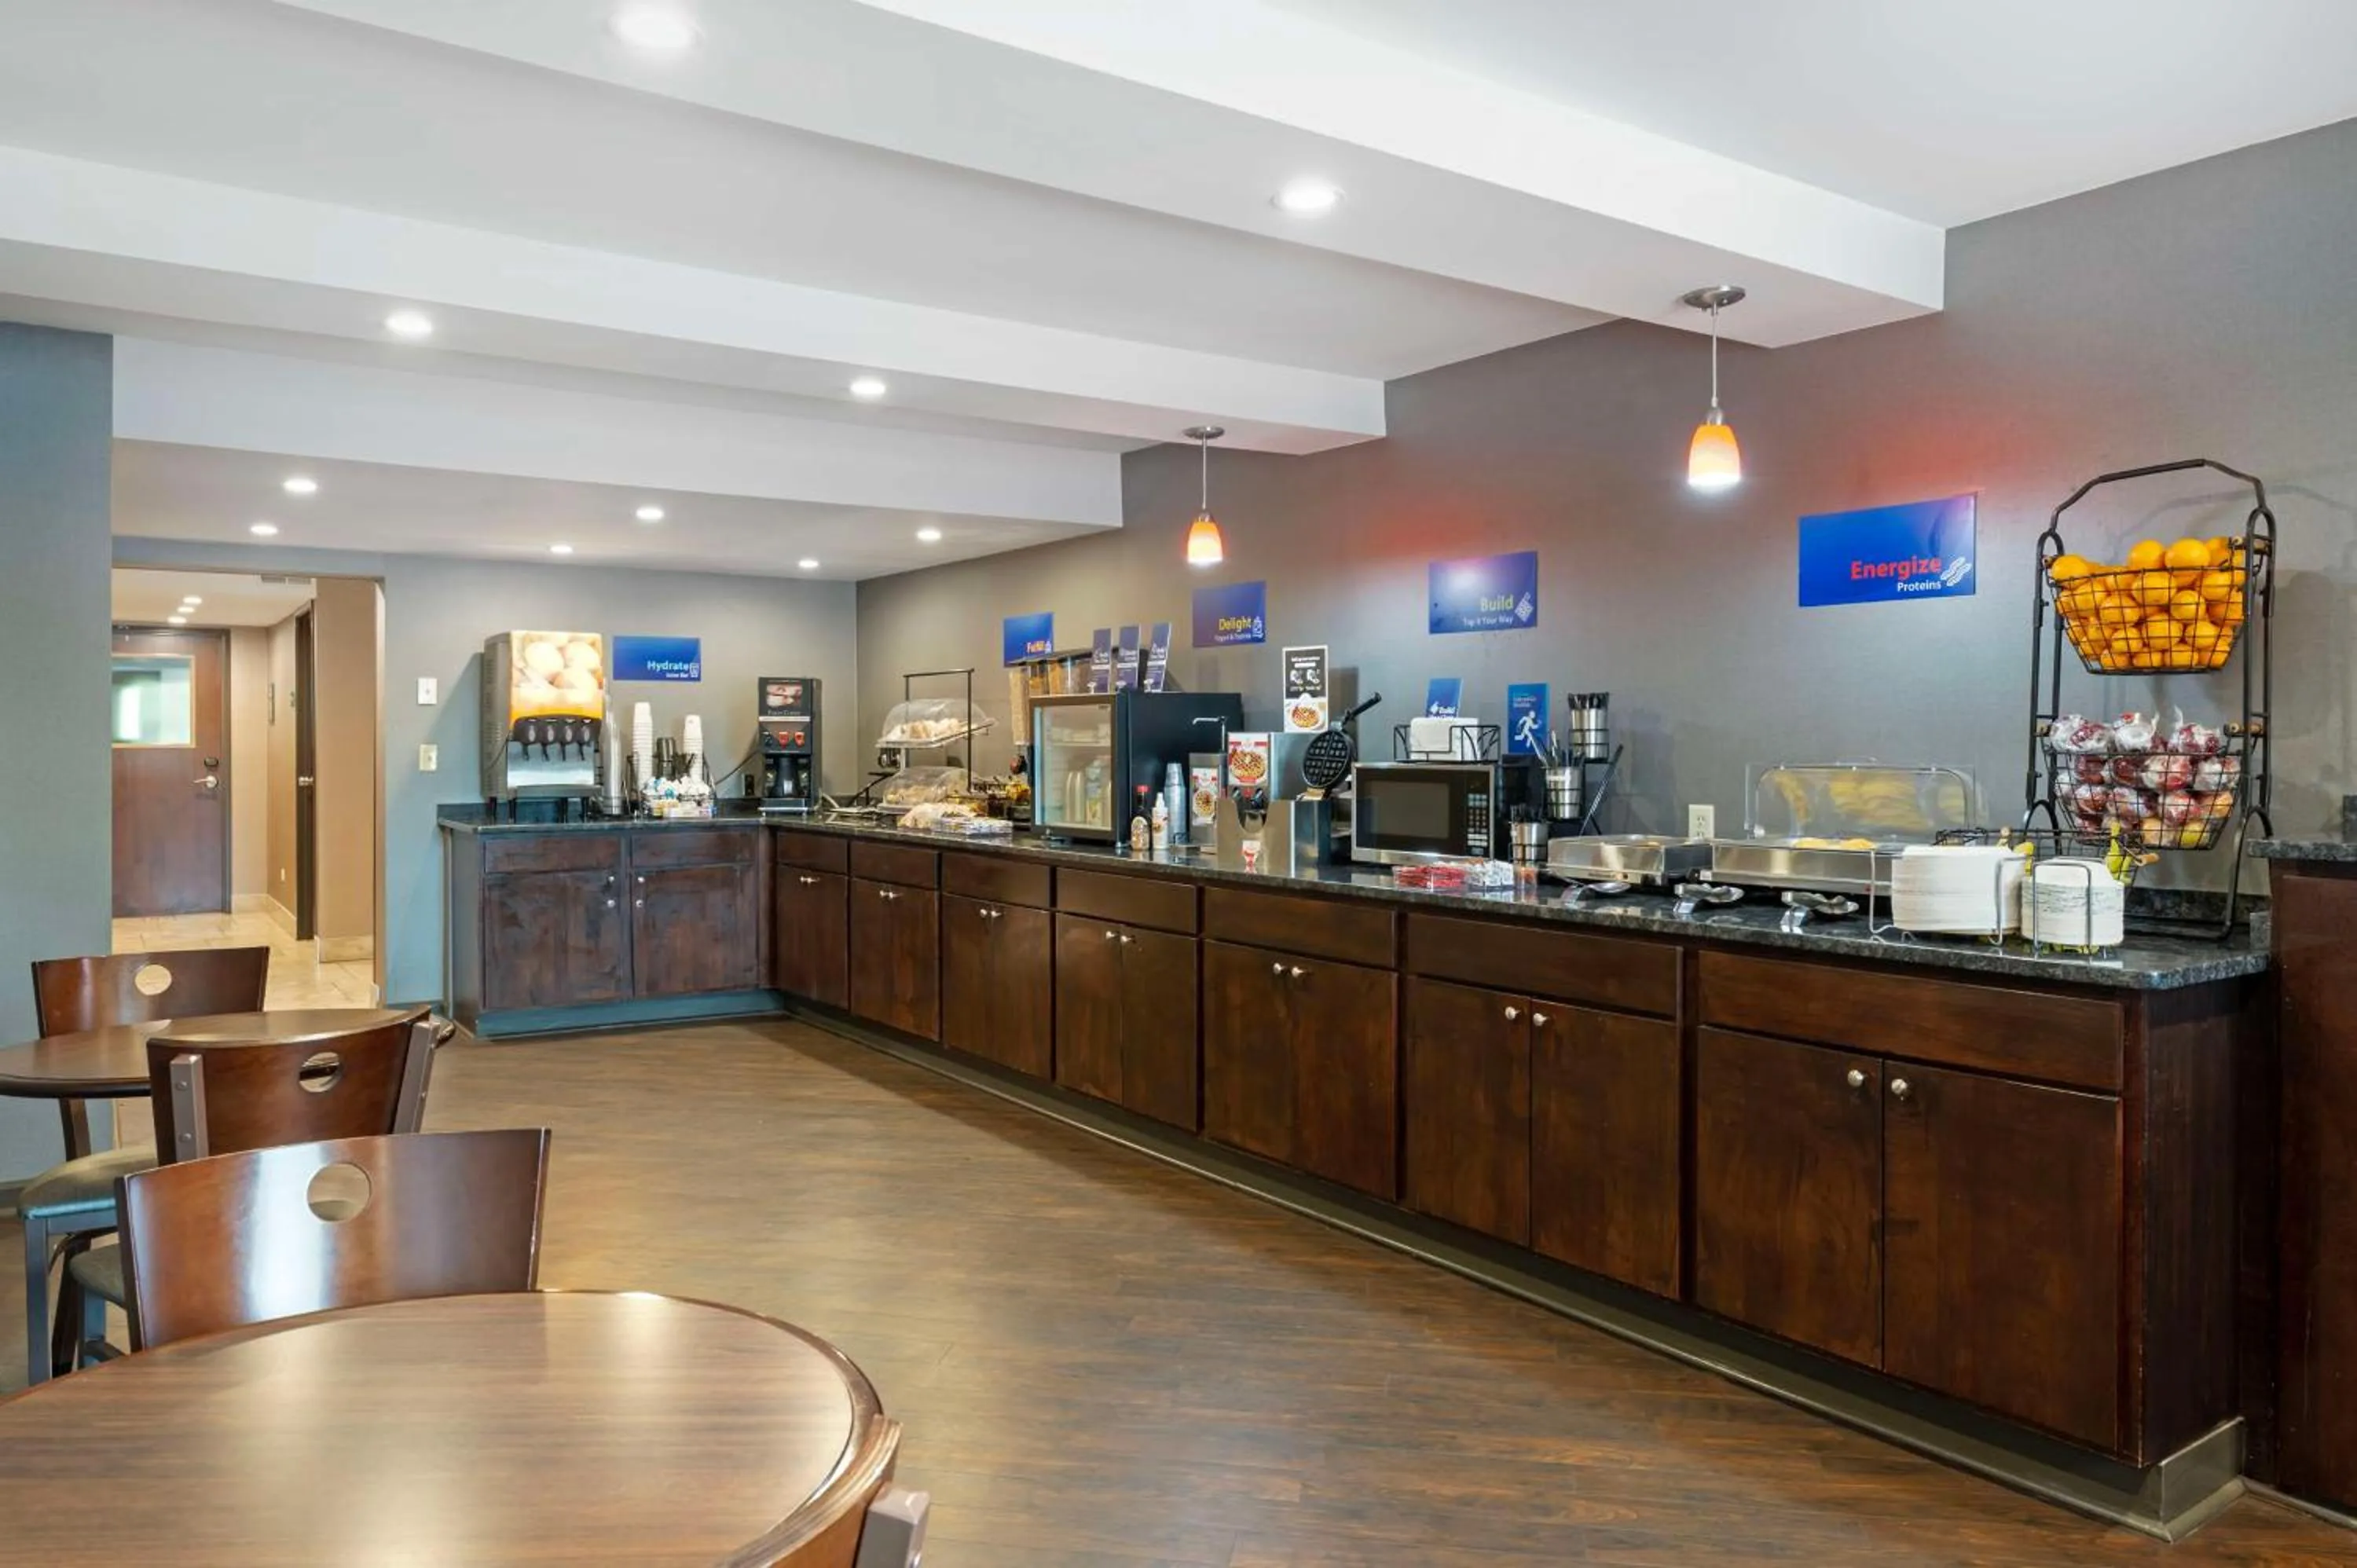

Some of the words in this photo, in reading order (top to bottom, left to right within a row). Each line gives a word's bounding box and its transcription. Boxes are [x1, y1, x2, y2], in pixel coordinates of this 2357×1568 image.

[1850, 555, 1942, 581] Energize
[1897, 580, 1942, 592] Proteins
[1479, 594, 1514, 612] Build
[1219, 616, 1252, 632] Delight
[1482, 616, 1497, 625] Your
[1498, 614, 1514, 625] Way
[647, 660, 689, 672] Hydrate
